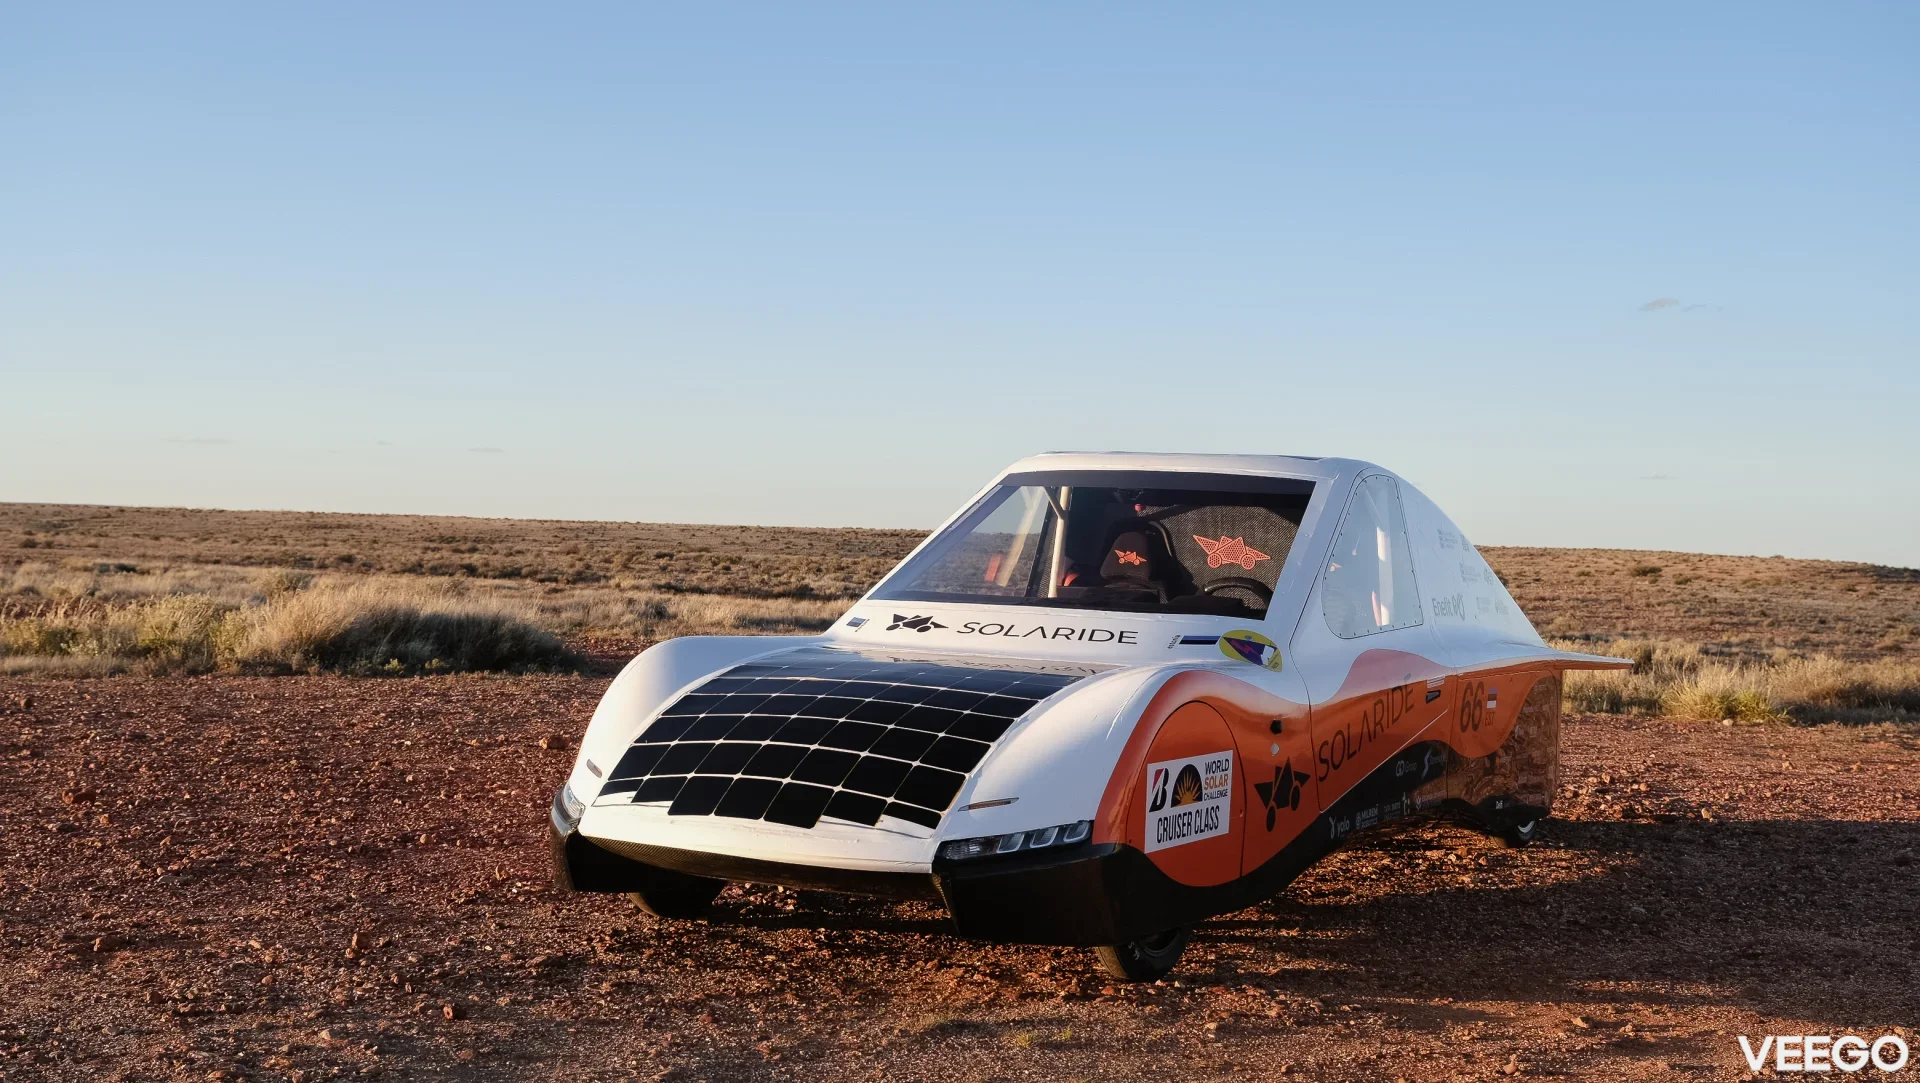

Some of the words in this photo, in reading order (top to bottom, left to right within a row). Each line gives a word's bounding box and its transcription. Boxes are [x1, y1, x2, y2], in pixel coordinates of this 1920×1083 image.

[1432, 597, 1453, 617] Enefit
[956, 621, 1139, 645] SOLARIDE
[1460, 681, 1485, 733] 66
[1318, 673, 1415, 782] SOLARIDE
[1484, 711, 1496, 726] EST
[1204, 759, 1229, 775] WORLD
[1203, 773, 1229, 791] SOLAR
[1203, 788, 1228, 801] CHALLENGE
[1157, 811, 1193, 843] CRUISER
[1194, 805, 1220, 835] CLASS
